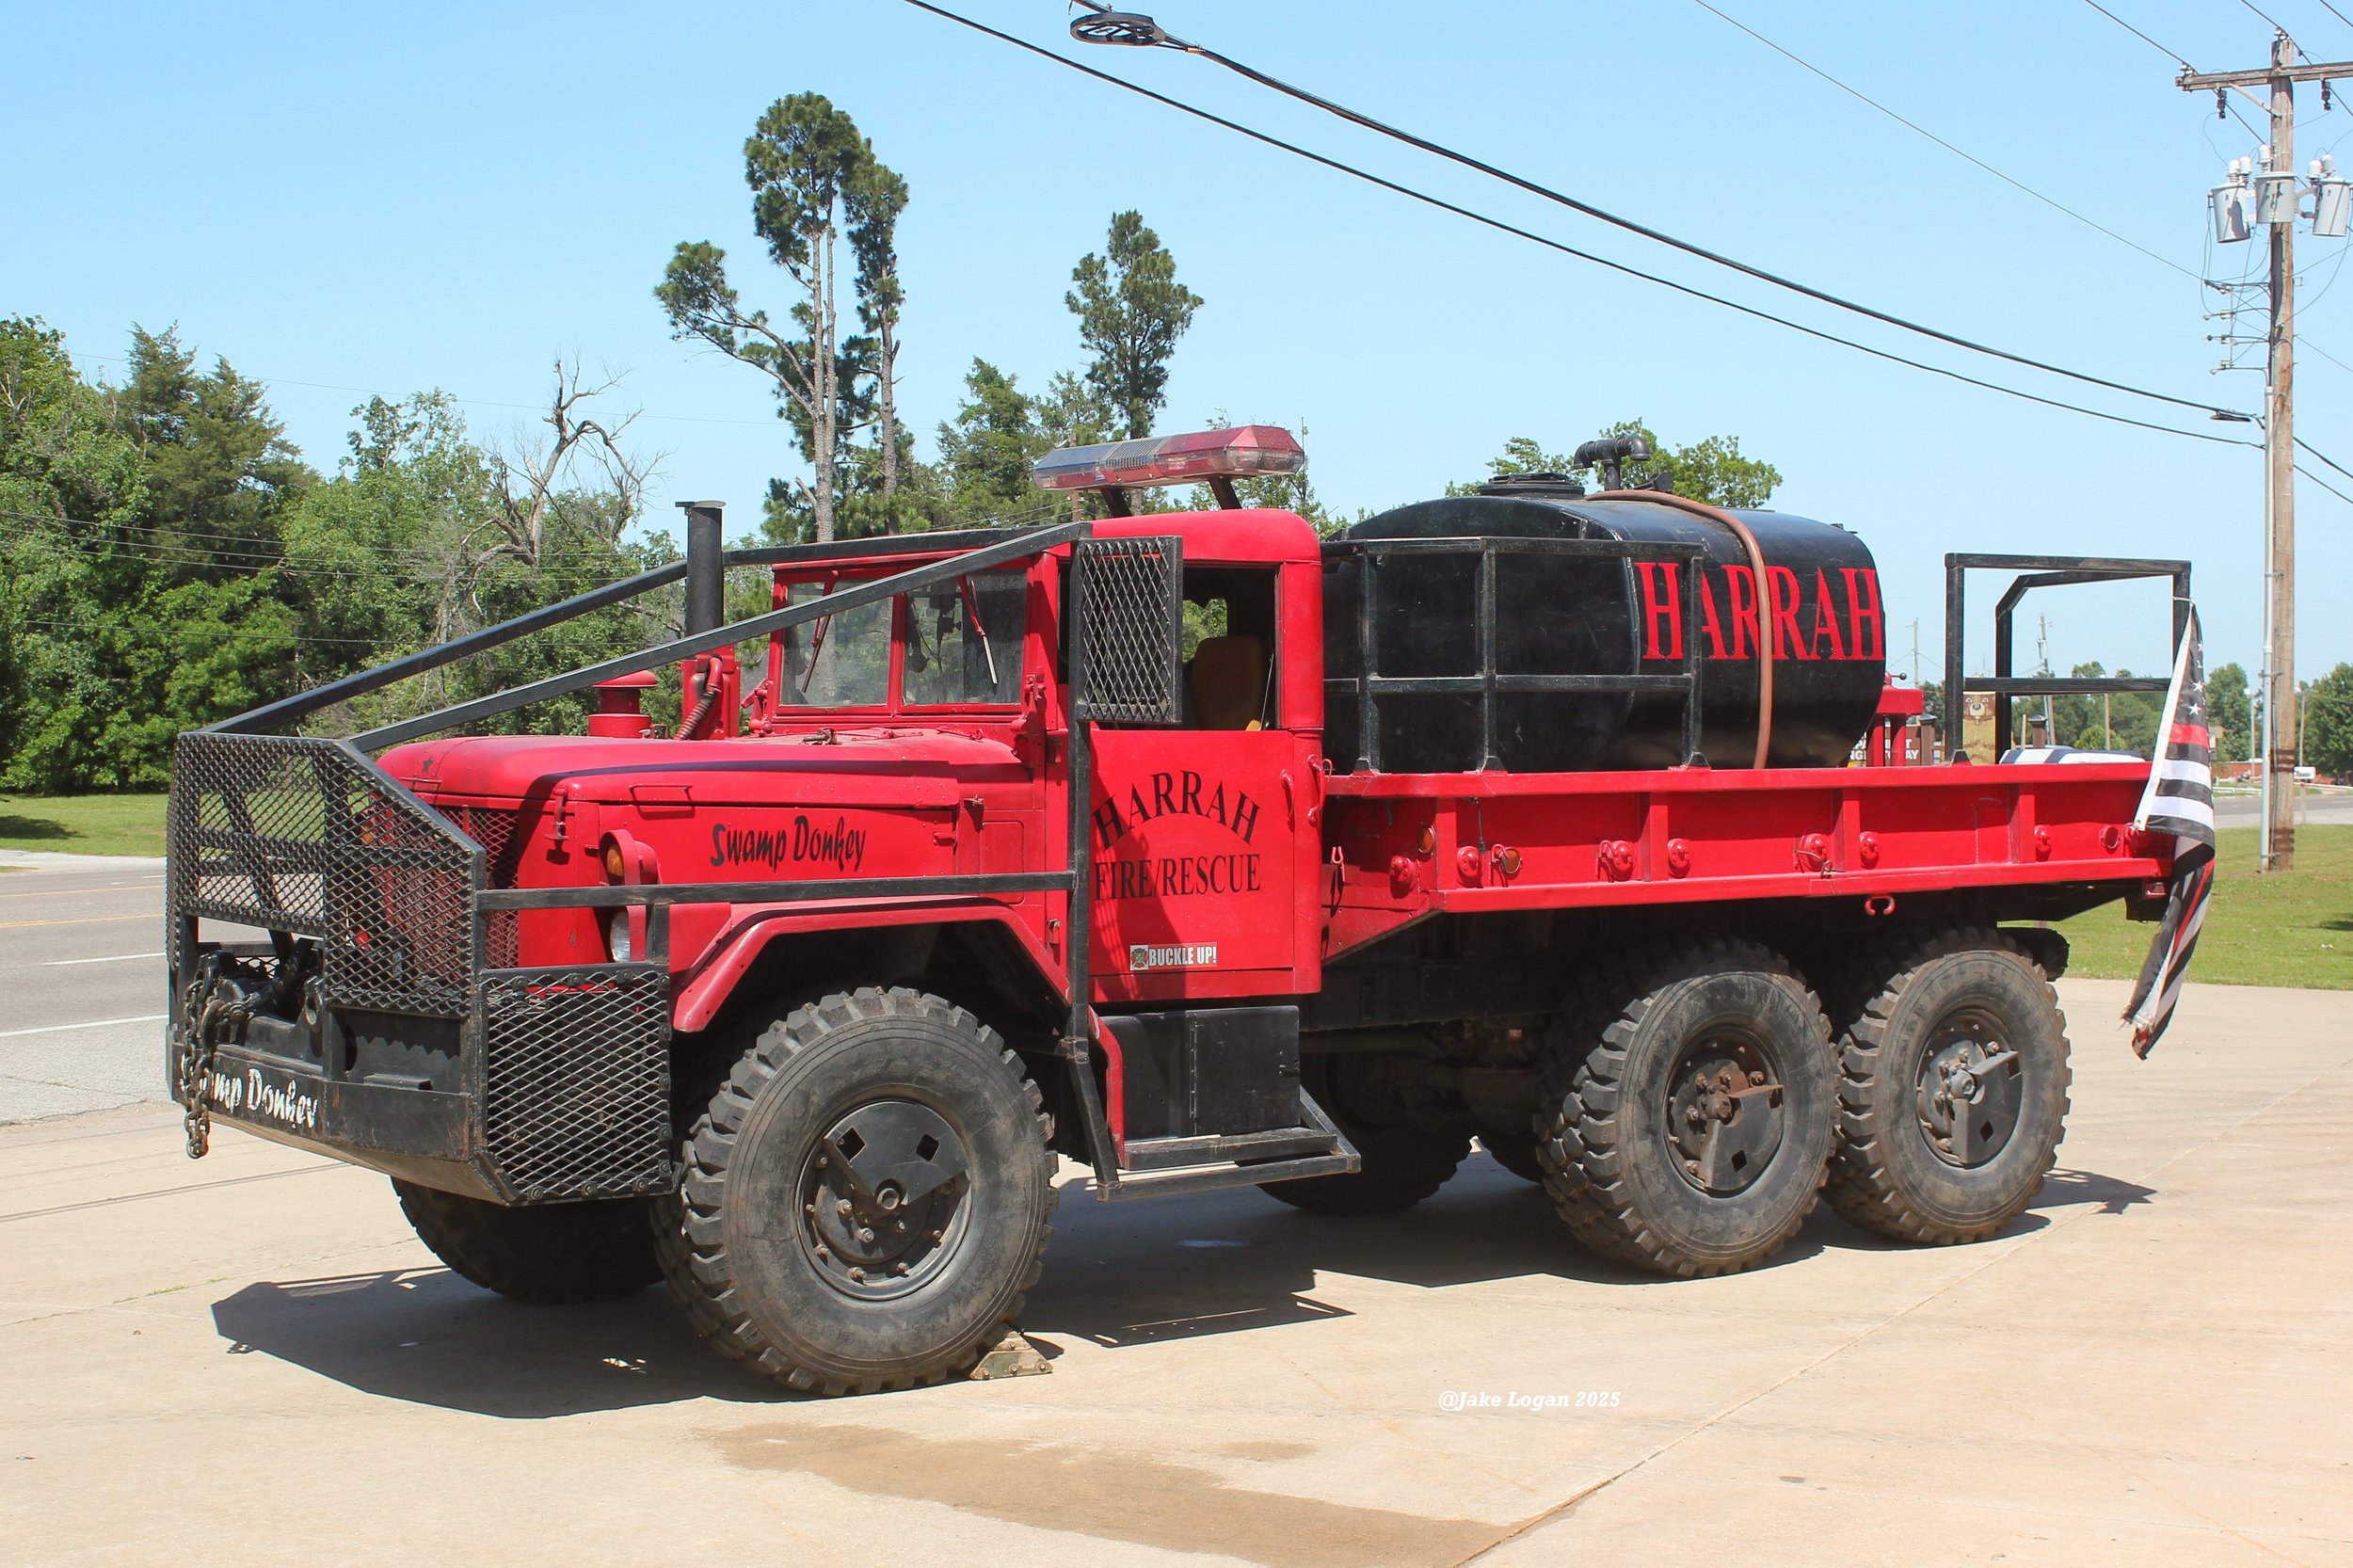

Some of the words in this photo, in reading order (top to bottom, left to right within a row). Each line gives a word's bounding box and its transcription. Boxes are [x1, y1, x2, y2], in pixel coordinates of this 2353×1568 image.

[1634, 562, 1885, 660] HARRAH
[1092, 770, 1262, 851] HARRAH
[711, 824, 787, 873] Swamp
[793, 815, 866, 872] Donkey
[1095, 854, 1261, 901] FIRE/RESCUE
[1148, 947, 1194, 967] BUCKLE
[1196, 946, 1217, 965] UP!
[247, 1067, 318, 1128] Donkey
